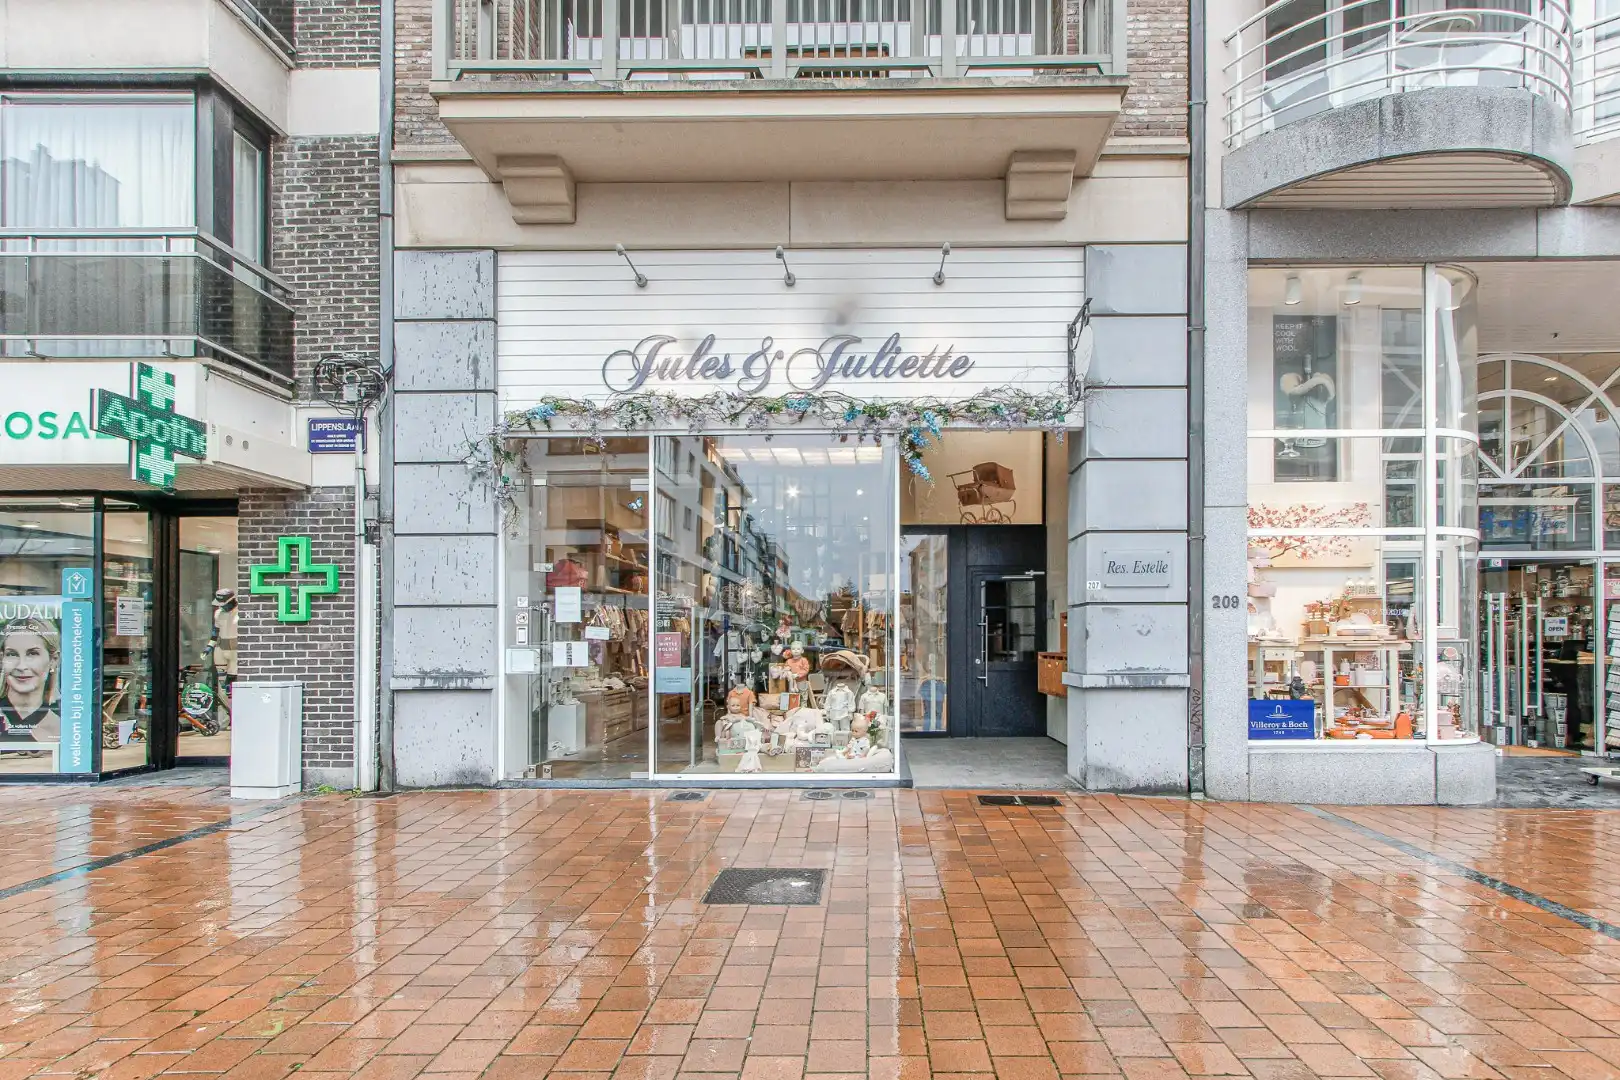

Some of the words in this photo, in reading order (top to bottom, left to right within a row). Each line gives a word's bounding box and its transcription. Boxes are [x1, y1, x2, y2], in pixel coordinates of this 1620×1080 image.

[1275, 344, 1298, 352] WOOL
[602, 333, 736, 393] Jules
[737, 336, 784, 394] &
[786, 332, 975, 391] Juliette
[0, 411, 118, 440] OSA
[1107, 560, 1129, 574] Res.
[1132, 560, 1169, 574] Estelle
[1088, 581, 1100, 589] 207
[1212, 595, 1240, 609] 209
[0, 603, 62, 620] UDALI
[71, 607, 85, 691] huisapotheker!
[71, 693, 85, 705] je
[70, 705, 84, 720] bij
[1250, 721, 1280, 729] Villeroy
[1288, 720, 1308, 728] Boch
[70, 722, 82, 768] welkom
